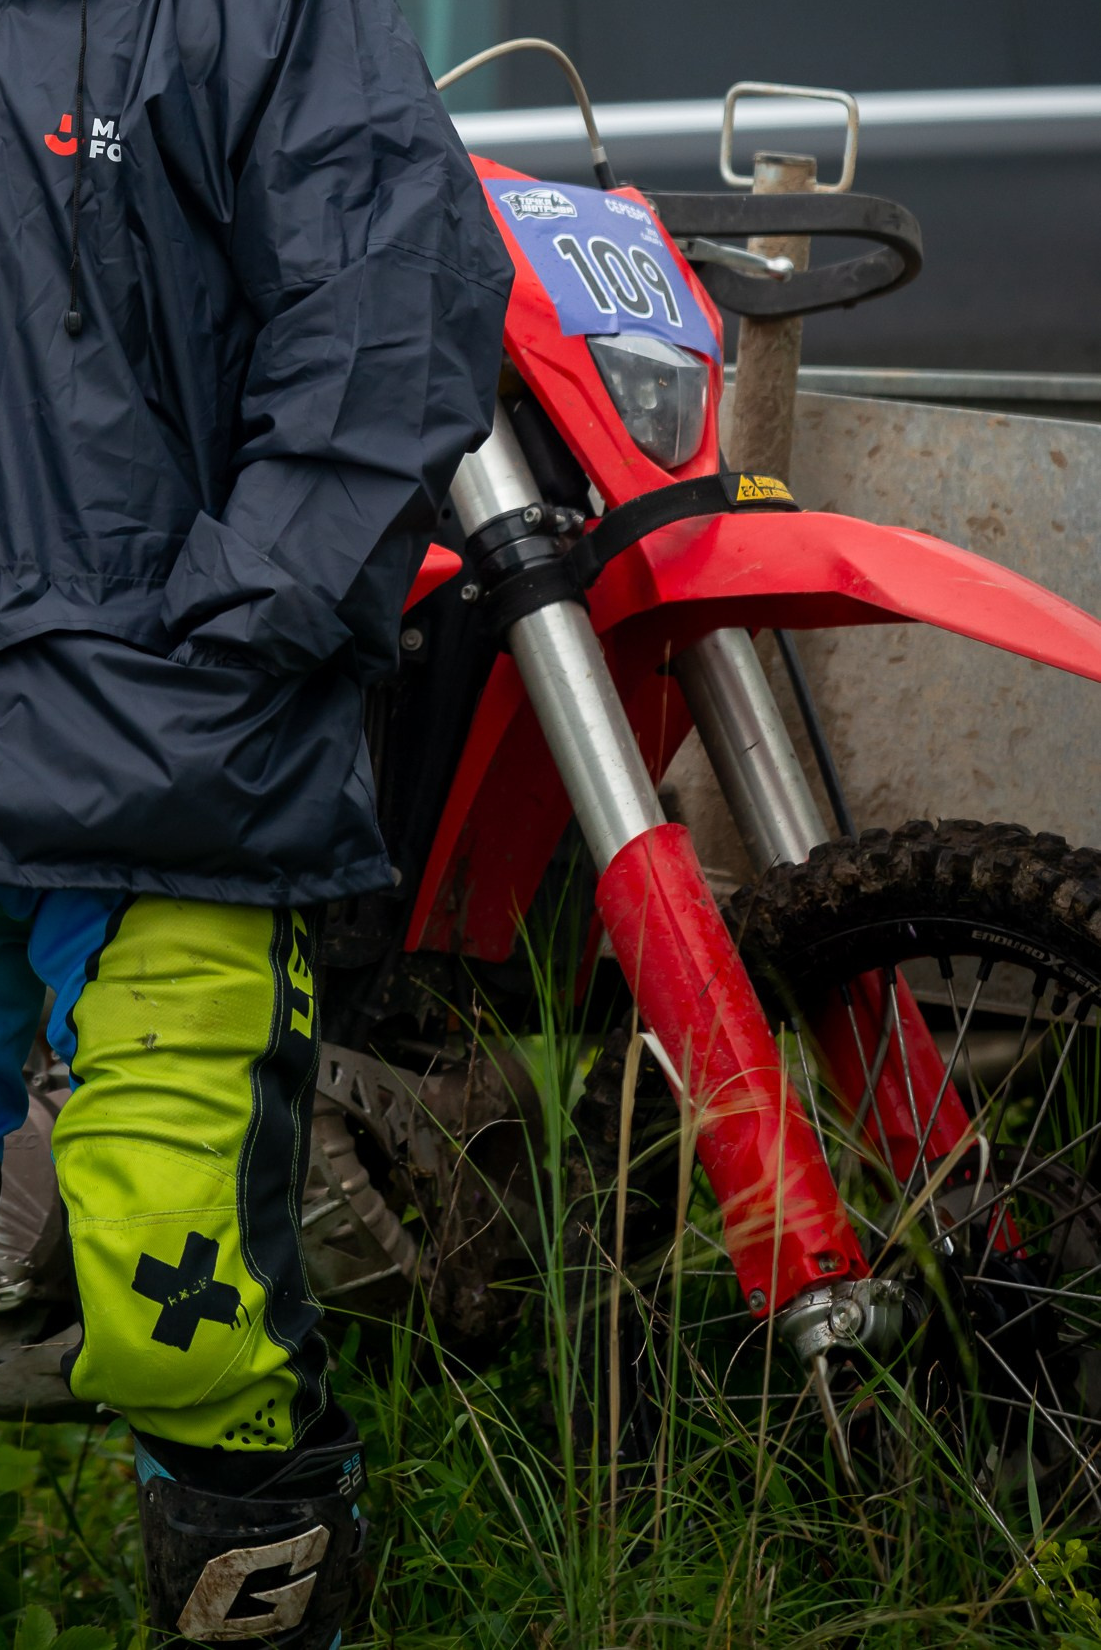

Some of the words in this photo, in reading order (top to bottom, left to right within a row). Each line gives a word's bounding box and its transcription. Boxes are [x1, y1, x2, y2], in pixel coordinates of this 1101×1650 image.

[91, 118, 121, 141] M
[552, 233, 683, 328] 109
[1062, 965, 1101, 997] SER
